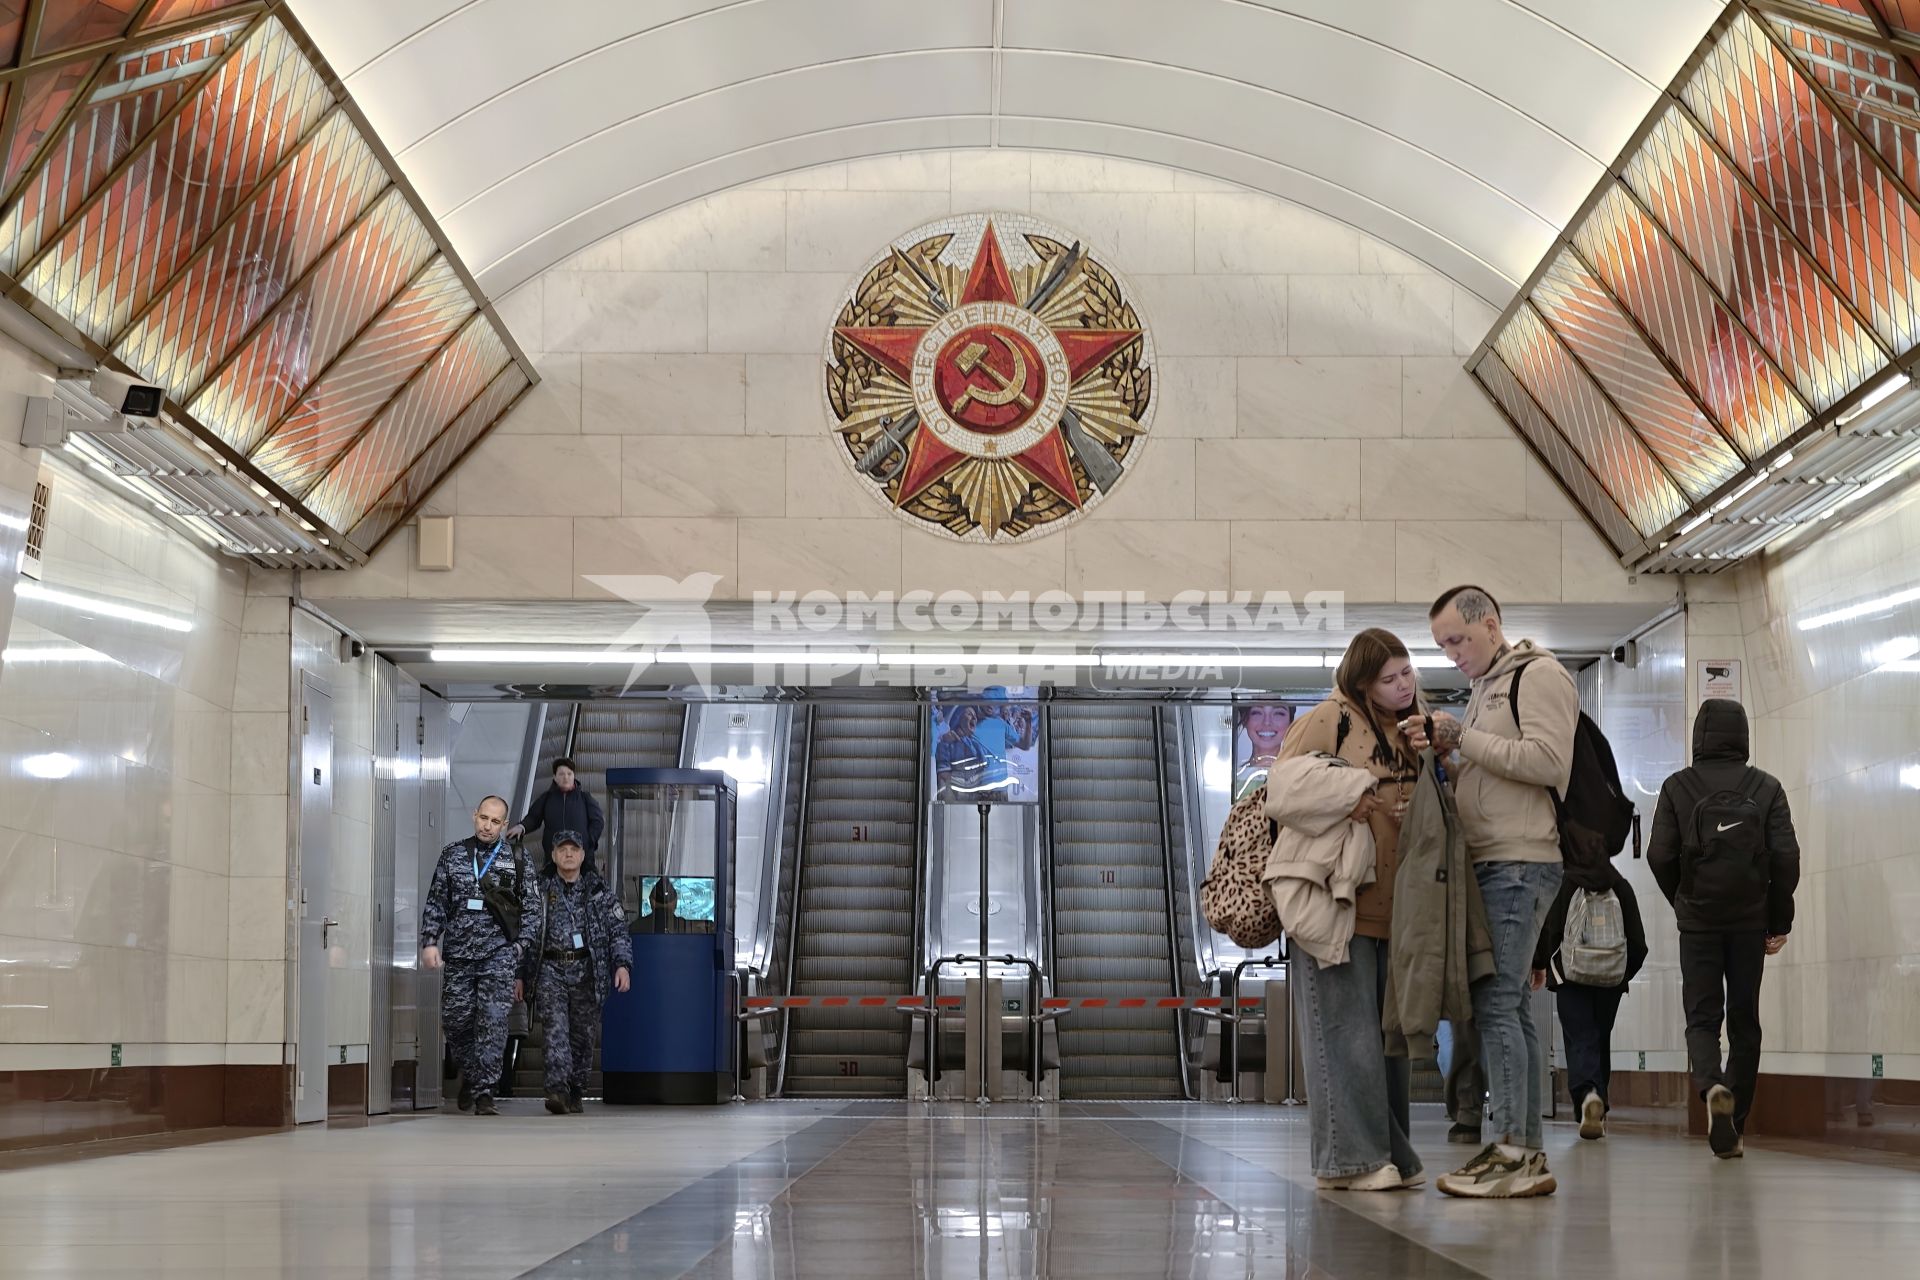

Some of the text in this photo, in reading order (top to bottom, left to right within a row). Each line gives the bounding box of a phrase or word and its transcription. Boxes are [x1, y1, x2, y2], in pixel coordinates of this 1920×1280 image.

[915, 303, 1050, 434] ОТЕЧЕСТВЕННАЯ
[852, 825, 868, 841] 31
[840, 1061, 858, 1077] 30
